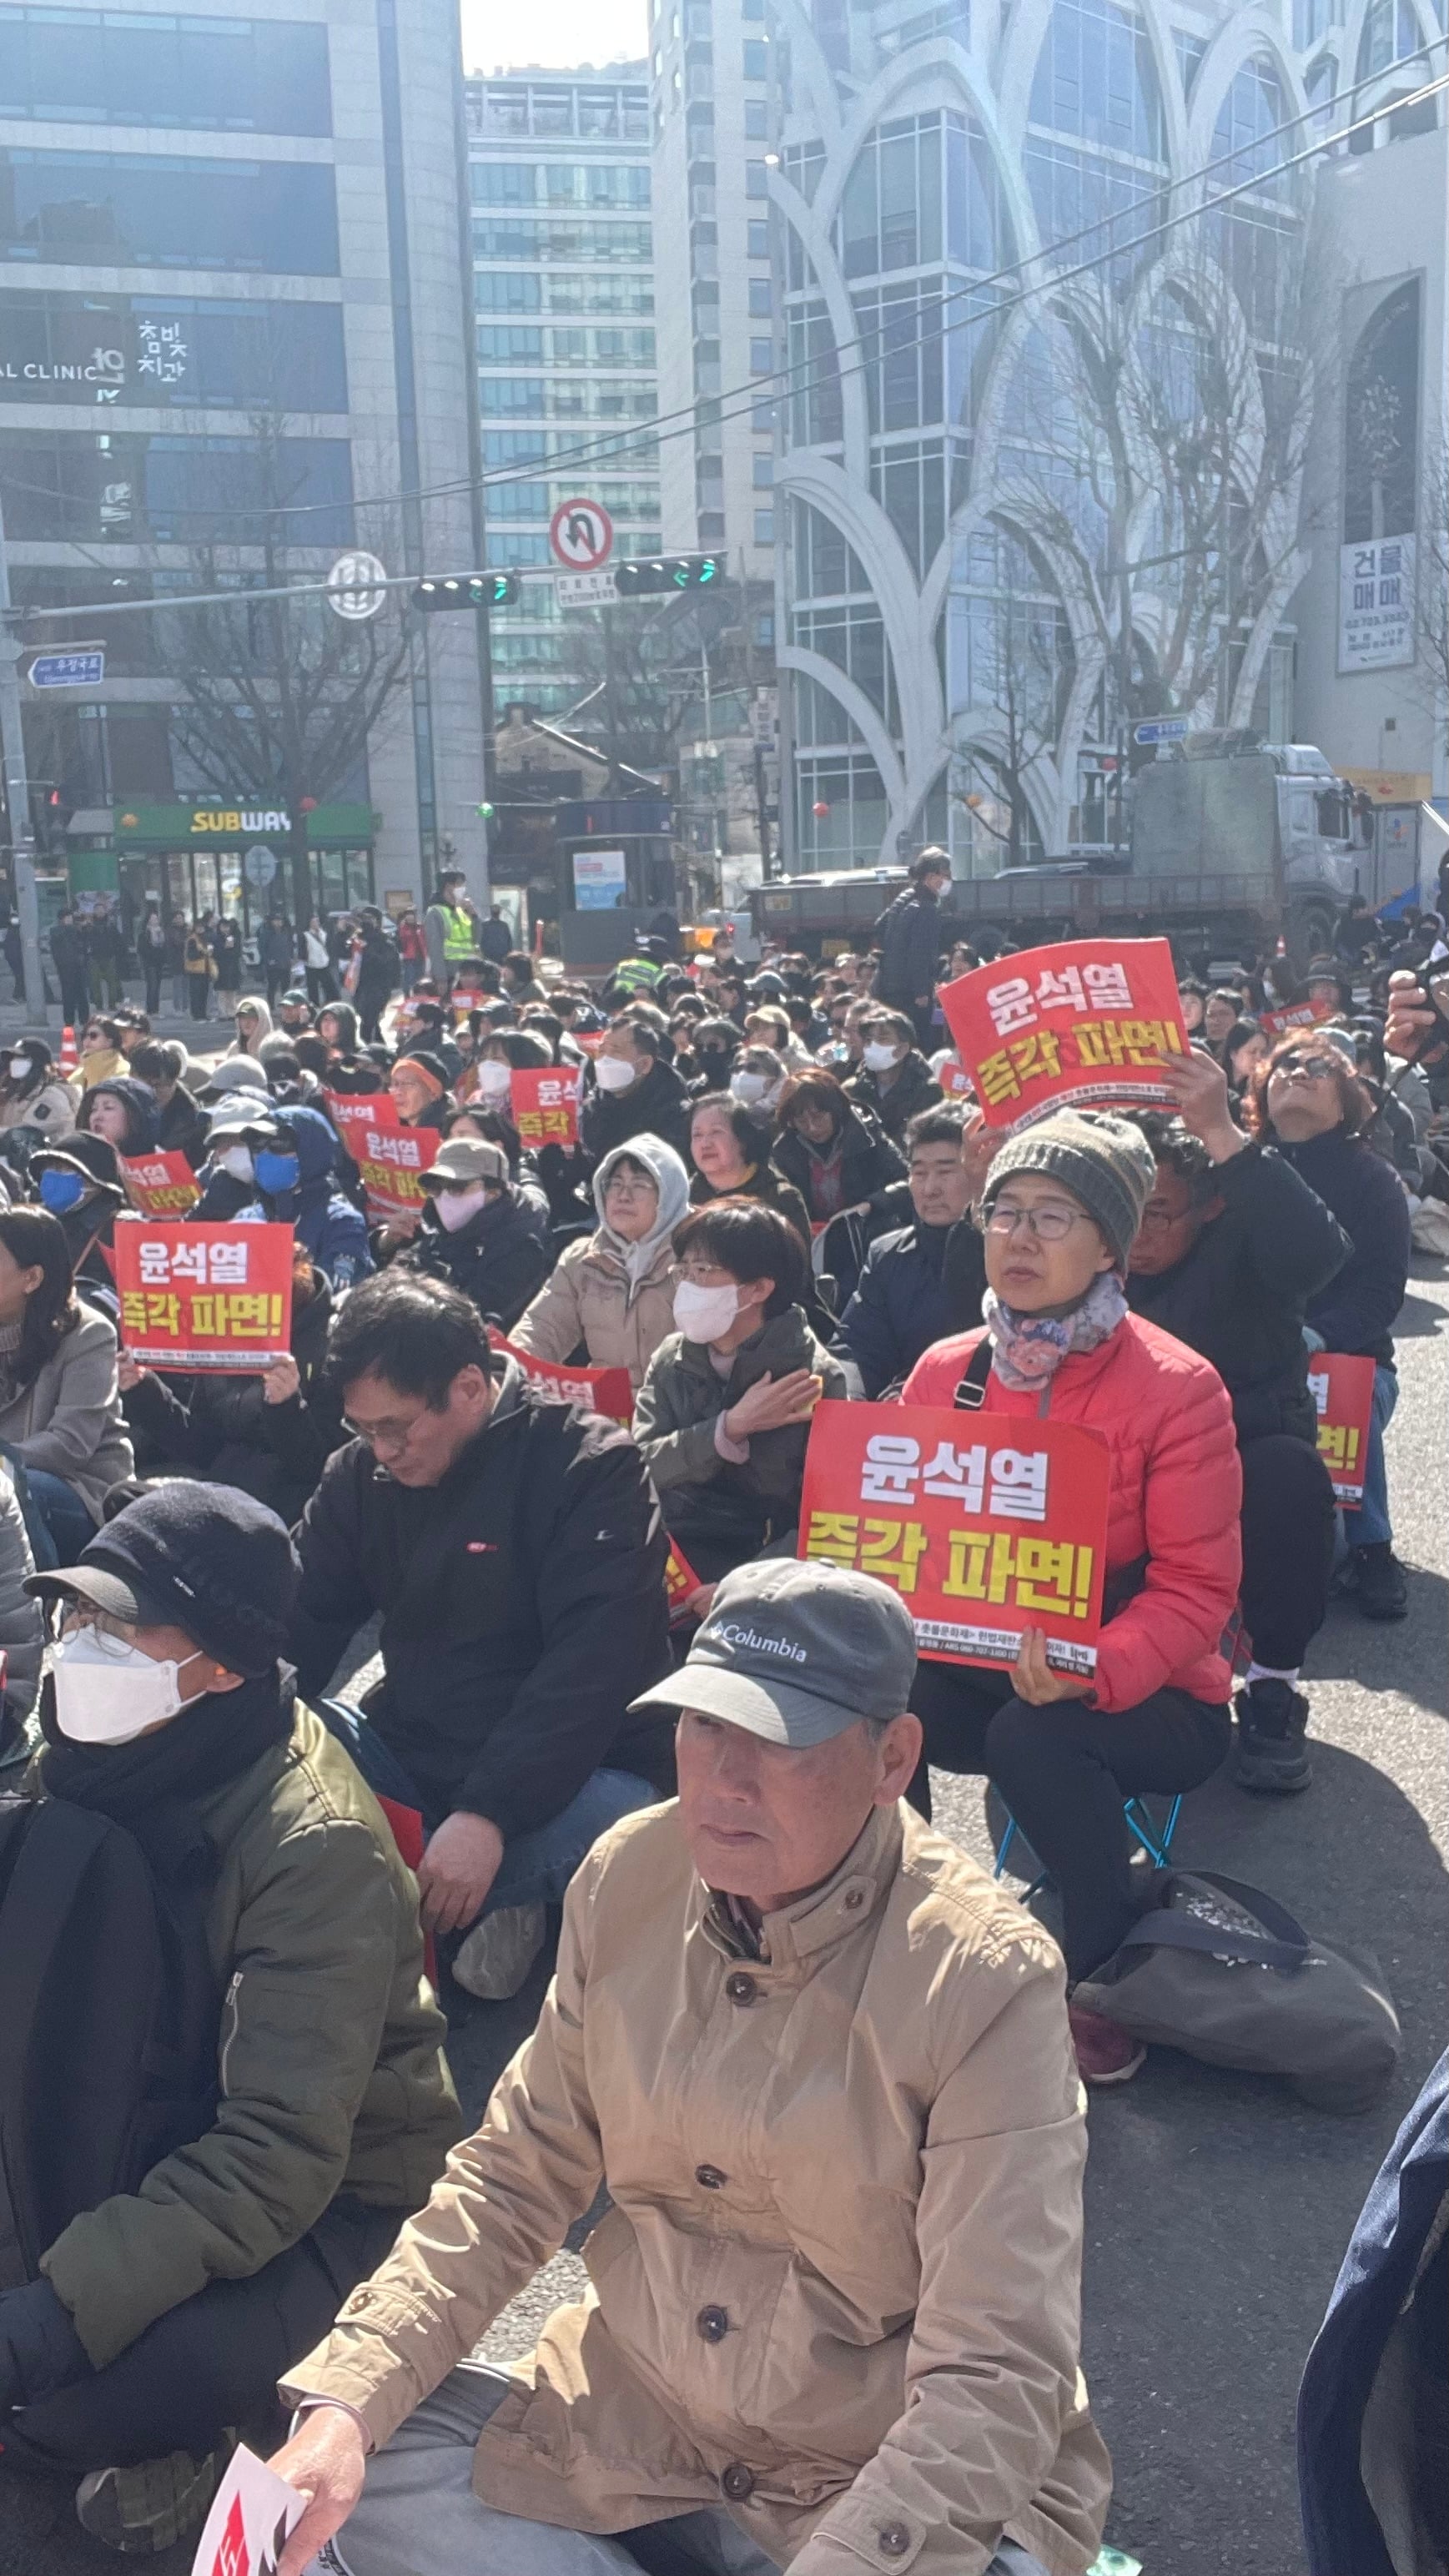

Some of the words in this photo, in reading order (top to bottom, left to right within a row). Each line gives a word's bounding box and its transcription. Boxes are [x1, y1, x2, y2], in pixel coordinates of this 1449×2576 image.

[23, 364, 97, 380] CLINIC
[137, 355, 186, 382] 치과
[1354, 545, 1401, 578] 건물
[1353, 576, 1401, 610] 매매
[190, 811, 291, 833] SUBWAY
[987, 963, 1135, 1036] 윤석열
[977, 1029, 1062, 1106] 즉각
[1072, 1020, 1183, 1067] 파면!
[519, 1111, 569, 1138] 즉각
[366, 1131, 420, 1167] 윤석열
[139, 1242, 248, 1285] 윤석열
[123, 1292, 181, 1336] 즉각
[190, 1294, 283, 1336] 파면!
[860, 1434, 1049, 1522] 윤석열
[806, 1511, 928, 1592] 즉각
[942, 1529, 1094, 1619] 파면!
[722, 1623, 808, 1663] Columbia
